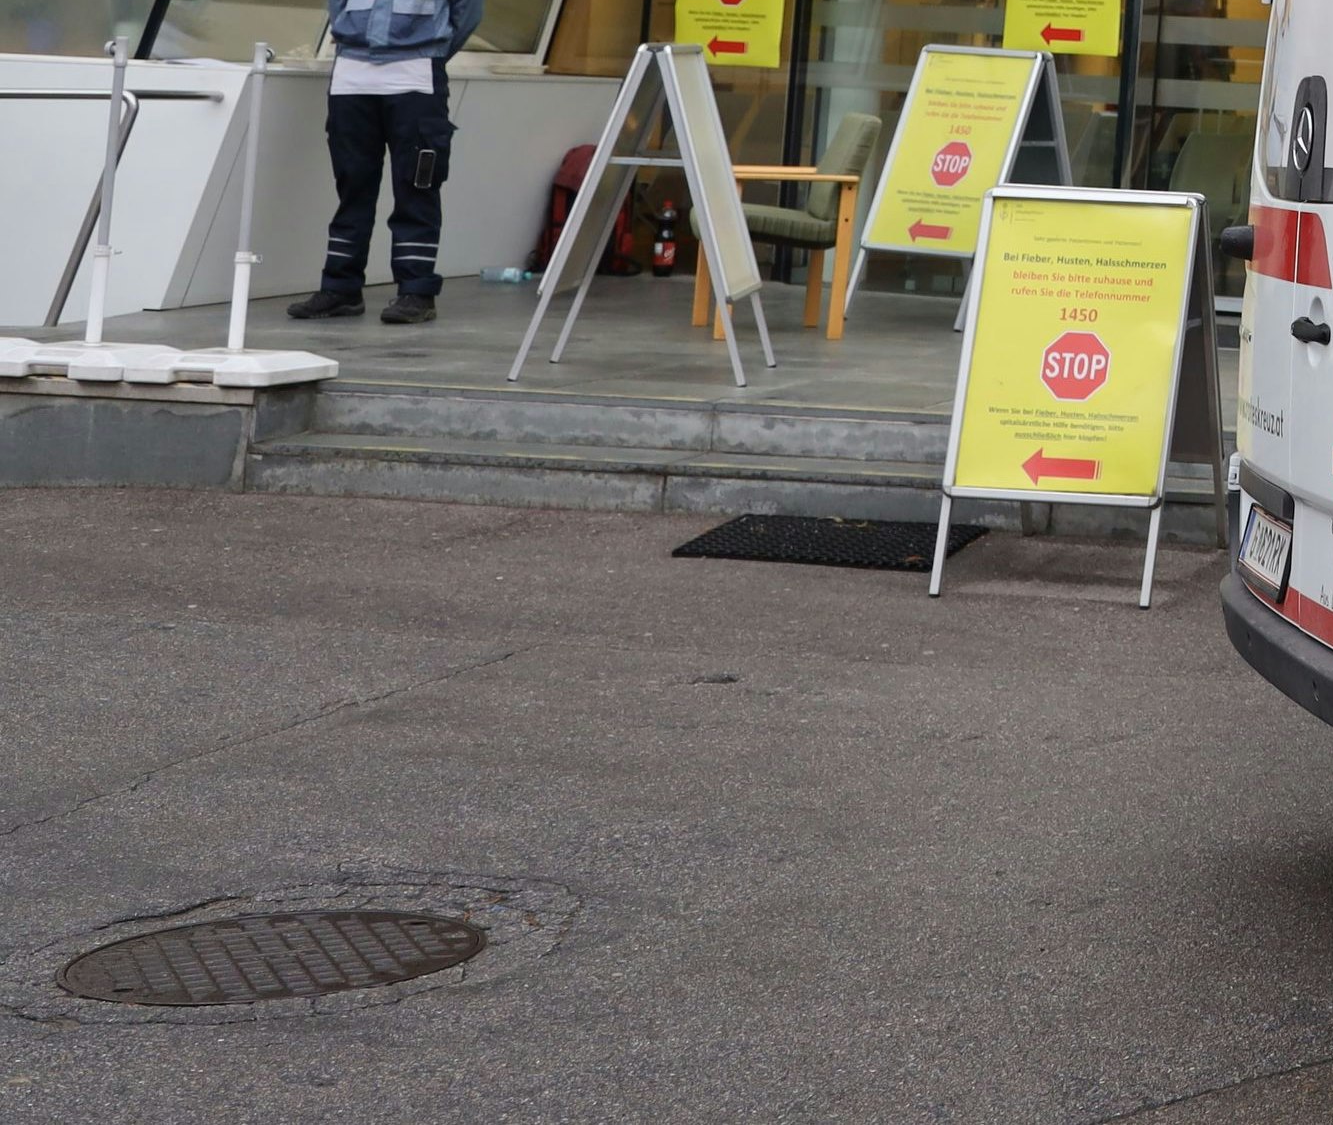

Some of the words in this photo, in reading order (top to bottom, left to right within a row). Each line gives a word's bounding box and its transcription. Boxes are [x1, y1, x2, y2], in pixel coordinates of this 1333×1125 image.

[949, 125, 972, 136] 1450
[933, 154, 970, 173] STOP
[1003, 252, 1019, 262] Bei
[1021, 253, 1052, 265] Fieber,
[1056, 256, 1093, 268] Husten,
[1096, 257, 1167, 270] Halsschmerzen
[1013, 270, 1049, 282] bleiben
[1051, 272, 1066, 282] Sie
[1068, 273, 1091, 284] bitte
[1093, 275, 1132, 286] zuhause
[1135, 277, 1153, 287] und
[1011, 286, 1037, 296] rufen
[1039, 287, 1054, 297] Sie
[1056, 288, 1071, 298] die
[1074, 289, 1151, 303] Telefonnummer
[1059, 307, 1098, 323] 1450
[1045, 351, 1106, 380] STOP
